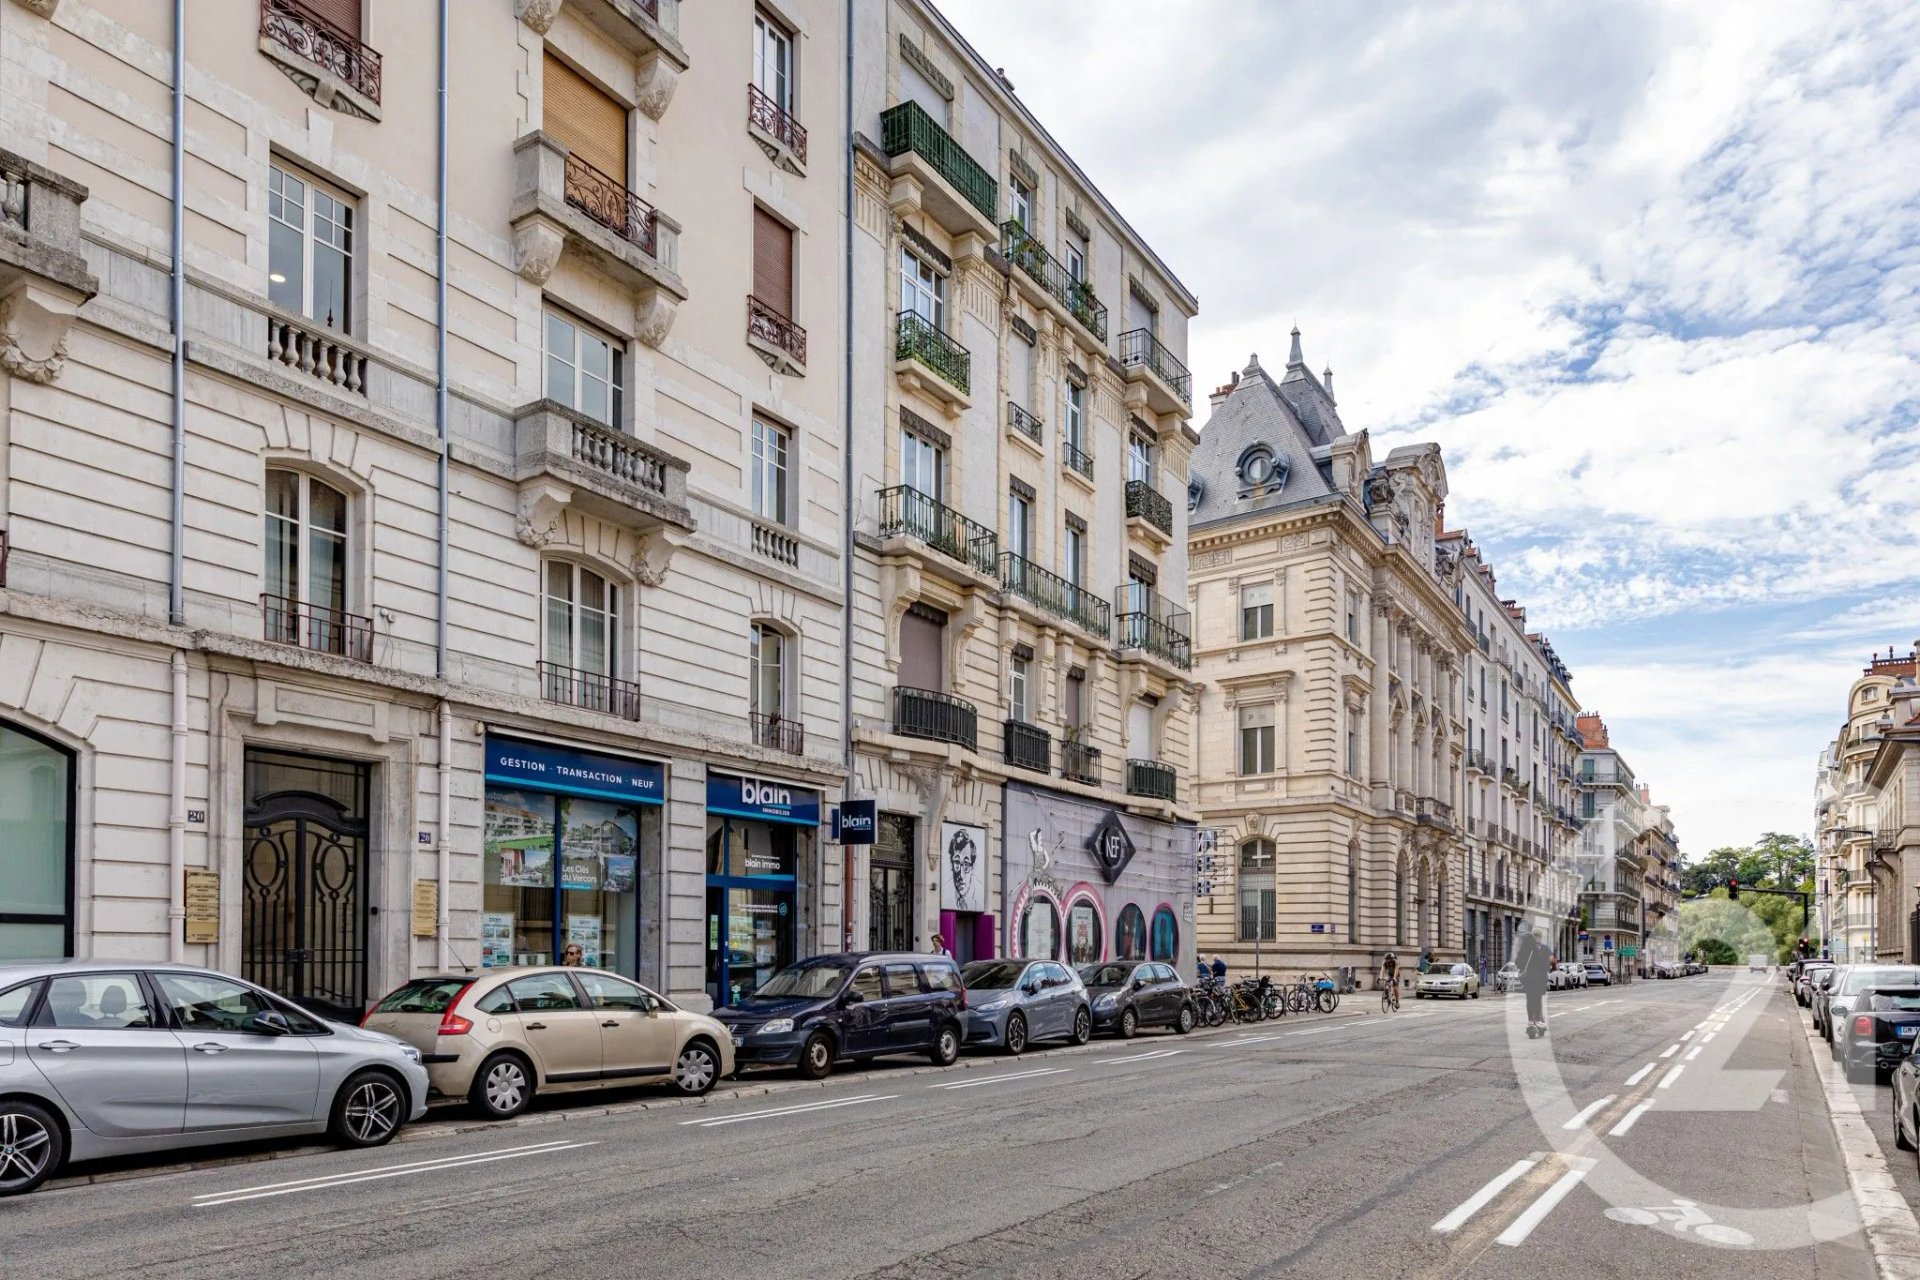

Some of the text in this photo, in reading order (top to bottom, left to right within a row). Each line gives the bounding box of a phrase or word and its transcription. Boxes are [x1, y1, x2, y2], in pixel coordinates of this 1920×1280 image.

[500, 757, 546, 772] GESTION
[556, 766, 622, 784] TRANSACTION
[631, 778, 654, 789] NEUF
[742, 777, 791, 805] blain
[189, 811, 204, 821] 20
[762, 807, 790, 816] IMMOBILIER
[841, 814, 872, 828] blain
[562, 864, 574, 873] Les
[745, 858, 780, 870] blain immo
[562, 873, 571, 881] du
